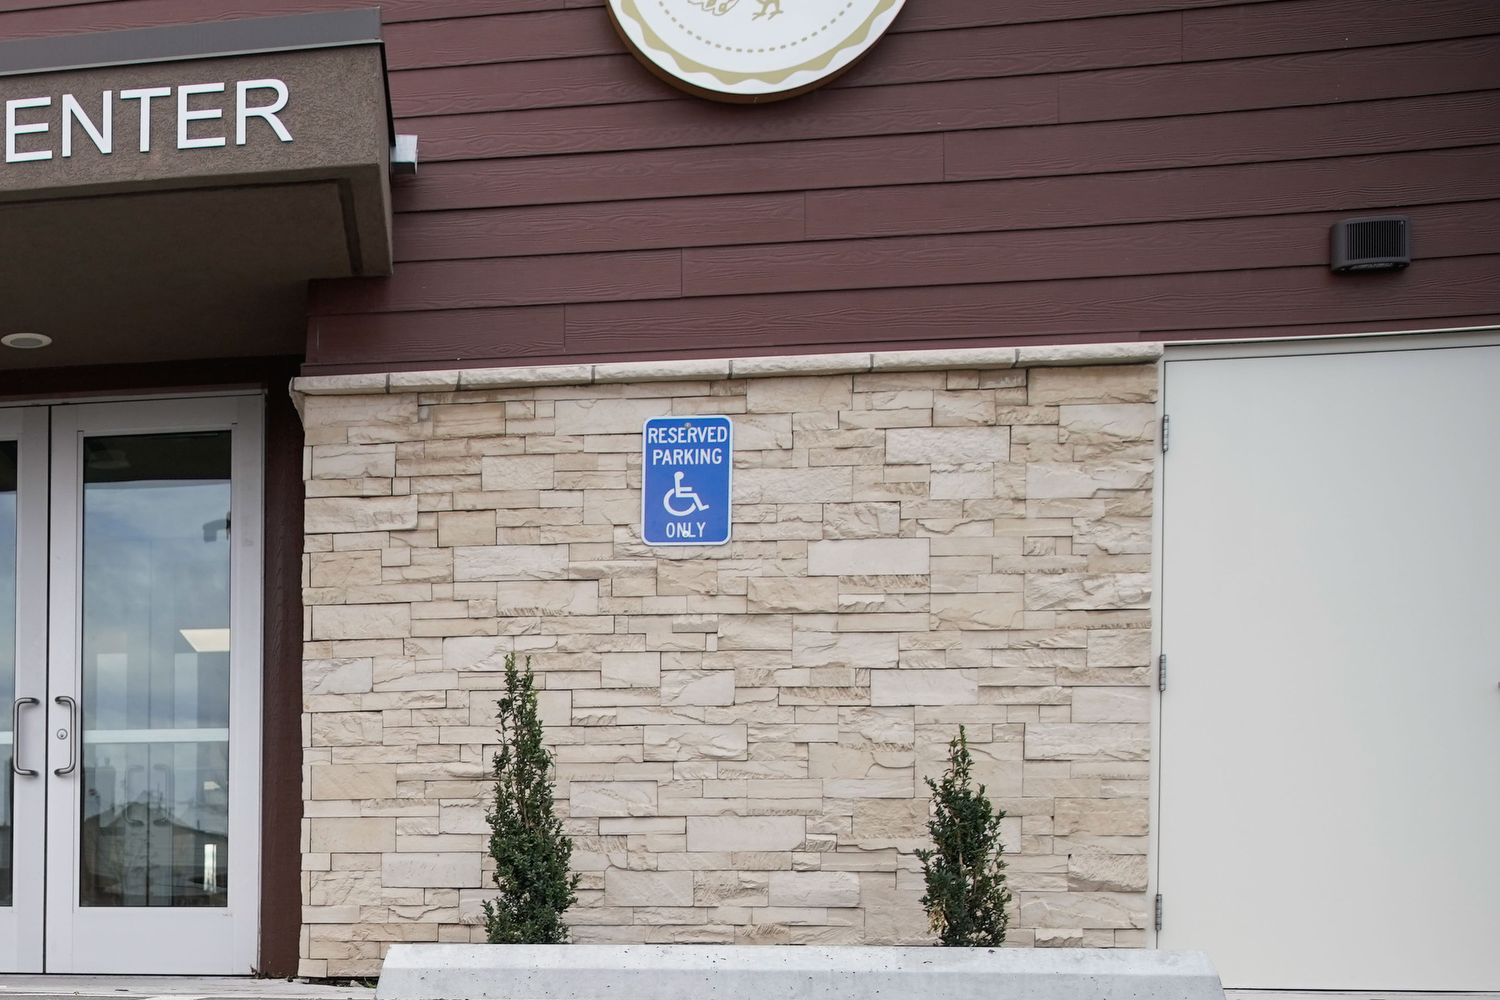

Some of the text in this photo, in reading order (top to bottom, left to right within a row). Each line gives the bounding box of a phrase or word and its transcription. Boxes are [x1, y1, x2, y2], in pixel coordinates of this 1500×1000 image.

[647, 426, 729, 444] RESERVED
[652, 448, 723, 466] PARKING
[665, 521, 707, 539] ONLY
